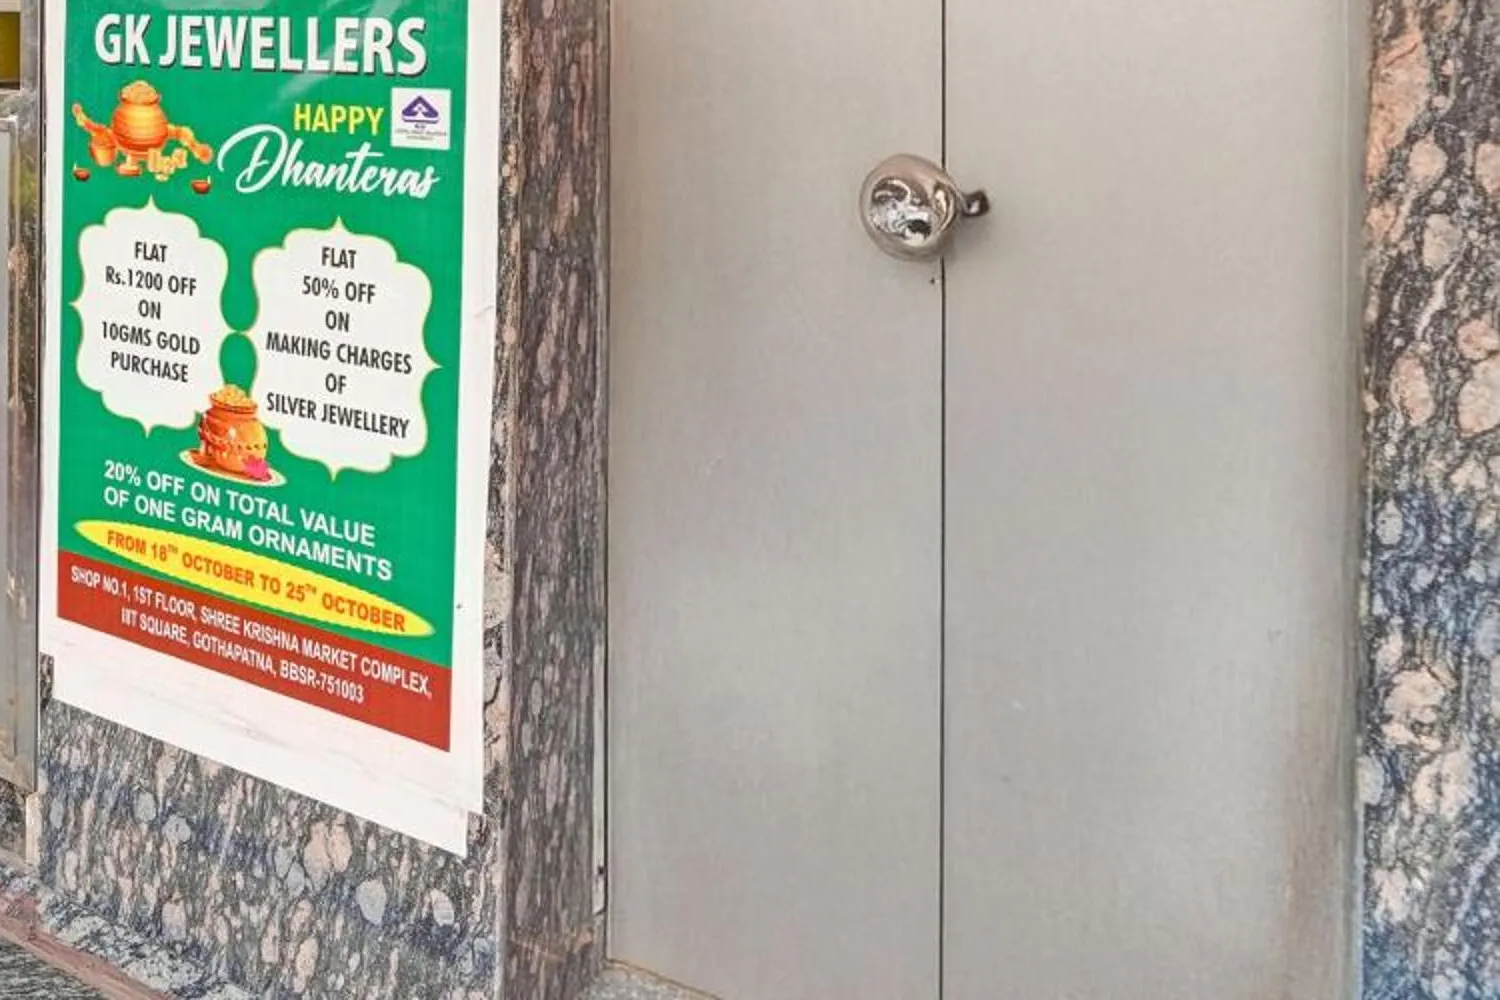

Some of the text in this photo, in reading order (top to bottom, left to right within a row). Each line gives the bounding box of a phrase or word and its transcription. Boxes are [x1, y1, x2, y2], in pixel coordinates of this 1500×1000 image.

[94, 13, 428, 78] GK JEWELLERS
[293, 103, 385, 137] HAPPY
[216, 123, 441, 199] Dhanteras
[134, 241, 168, 263] FLAT
[321, 246, 357, 270] FLAT
[105, 265, 197, 297] Rs.1200 OFF
[302, 275, 376, 305] 50% OFF
[137, 299, 162, 320] ON
[324, 310, 350, 333] ON
[101, 321, 201, 356] 10GMS GOLD
[265, 331, 414, 376] MAKING CHARGES
[110, 351, 190, 384] PURCHASE
[324, 373, 347, 395] OF
[266, 391, 411, 440] SILVER JEWELLERY
[104, 459, 377, 548] 20% OFF ON TOTAL VALUE
[103, 486, 394, 582] OF ONE GRAM ORNAMENTS
[106, 529, 147, 556] FROM
[182, 551, 256, 588] OCTOBER
[259, 573, 281, 595] TO
[321, 592, 406, 633] OCTOBER
[70, 564, 100, 589] SHOP
[133, 585, 154, 606] 1ST
[200, 605, 241, 635] SHREE
[243, 619, 300, 655] KRISHNA
[302, 637, 358, 673] MARKET
[360, 656, 433, 701] COMPLEX,
[192, 630, 277, 678] GOTHAPATNA,
[279, 658, 365, 705] BBSR-751003
